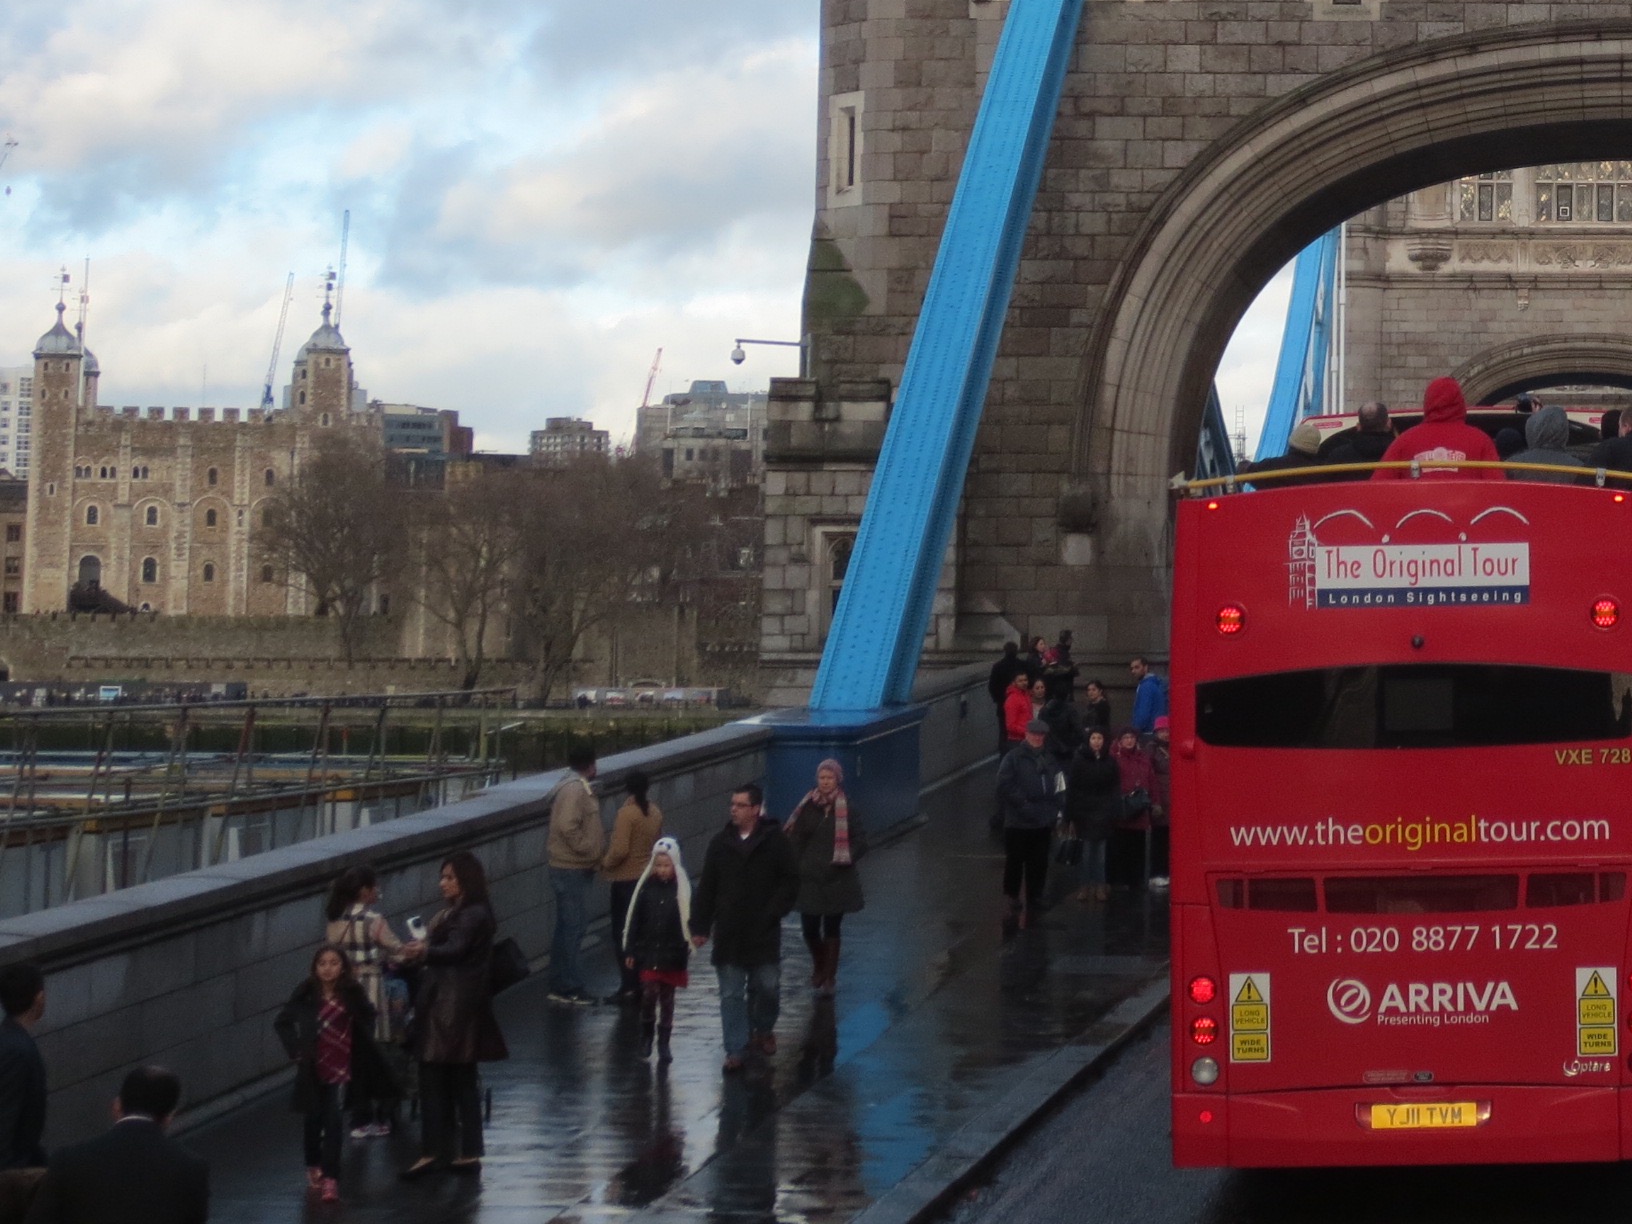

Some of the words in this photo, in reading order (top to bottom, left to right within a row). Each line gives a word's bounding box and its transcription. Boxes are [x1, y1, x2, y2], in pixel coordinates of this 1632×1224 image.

[1325, 547, 1361, 579] The
[1372, 545, 1462, 586] Original
[1471, 546, 1519, 577] Tour
[1328, 592, 1395, 604] London
[1406, 590, 1522, 606] Sightseeing
[1554, 749, 1593, 765] VXE
[1599, 748, 1631, 764] 728
[1229, 815, 1611, 851] www.theoriginaltour.com
[1349, 927, 1400, 953] 020
[1411, 926, 1480, 952] 8877
[1491, 924, 1559, 950] 1722
[1377, 981, 1519, 1013] ARRIVA
[1235, 1017, 1265, 1025] VEHICLE
[1239, 1009, 1260, 1017] LONG
[1377, 1014, 1440, 1027] Presenting
[1444, 1012, 1490, 1025] London
[1582, 1011, 1612, 1019] VEHICLE
[1239, 1039, 1262, 1047] WIDE
[1426, 1107, 1462, 1124] TVM
